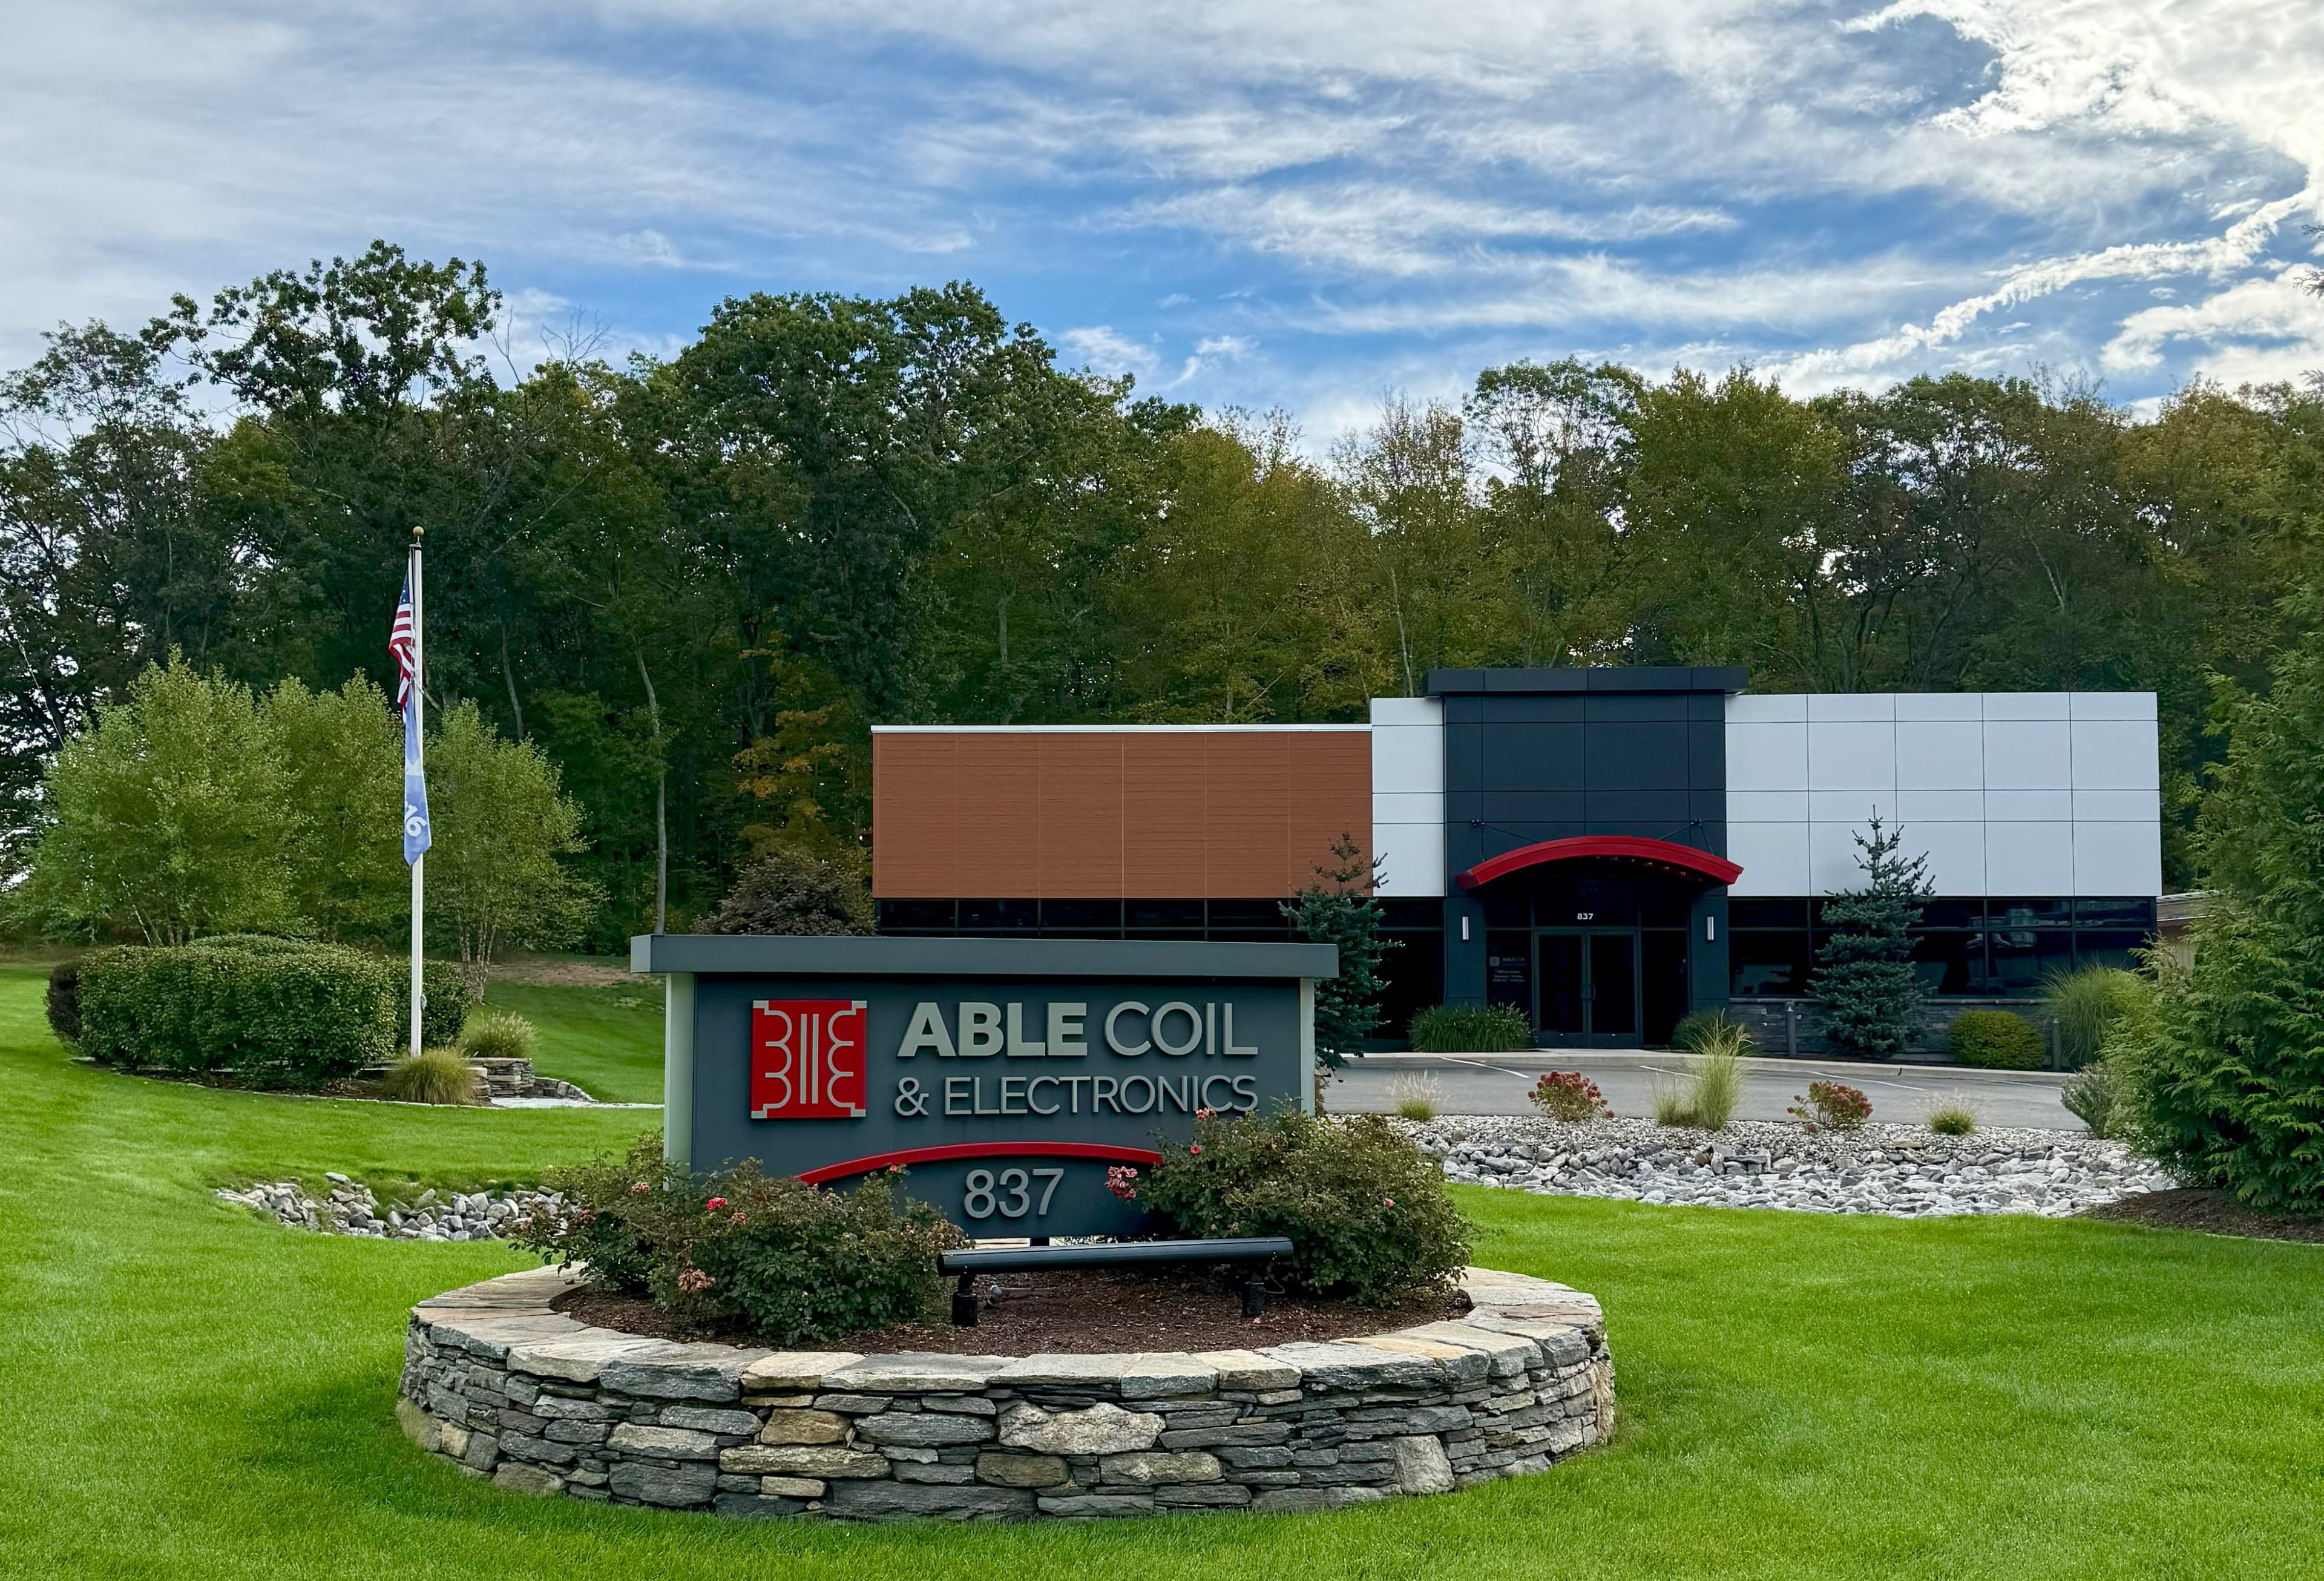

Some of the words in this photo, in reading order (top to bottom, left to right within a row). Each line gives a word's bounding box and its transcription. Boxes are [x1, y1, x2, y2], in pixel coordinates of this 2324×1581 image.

[897, 1002, 1088, 1056] ABLE
[1105, 1001, 1258, 1056] COIL
[894, 1076, 929, 1116] &
[944, 1074, 1258, 1115] ELECTRONICS
[963, 1168, 1065, 1218] 837
